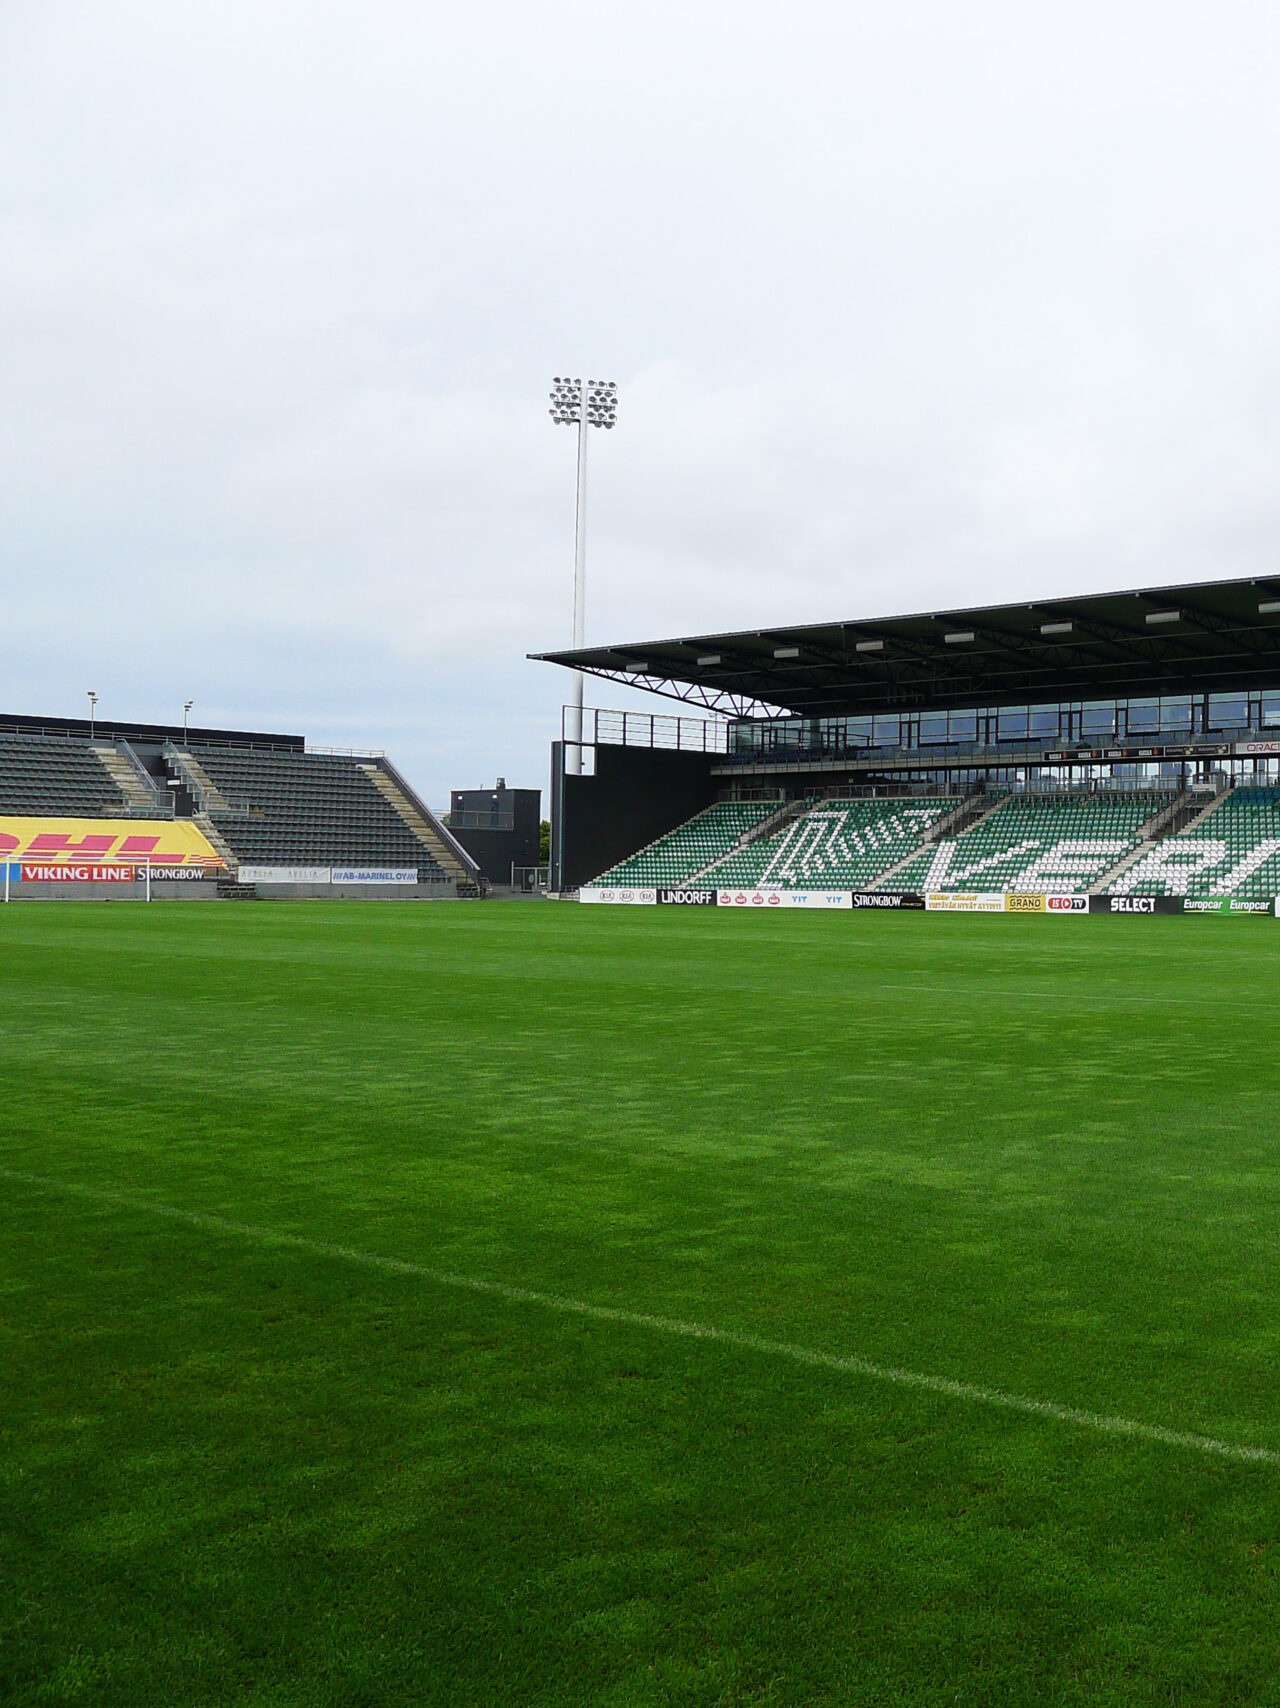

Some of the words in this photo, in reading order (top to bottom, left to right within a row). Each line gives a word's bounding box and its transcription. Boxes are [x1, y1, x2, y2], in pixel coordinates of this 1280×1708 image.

[0, 832, 185, 863] HL
[24, 866, 88, 880] VIKING
[93, 867, 130, 880] LINE
[661, 890, 712, 904] LINDORFF
[853, 894, 904, 908] STRONGBOW
[1009, 899, 1041, 908] GRANO
[1072, 898, 1083, 908] TV
[1183, 898, 1223, 909] Europcar
[1110, 898, 1155, 912] SELECT
[1229, 899, 1270, 910] Europcar
